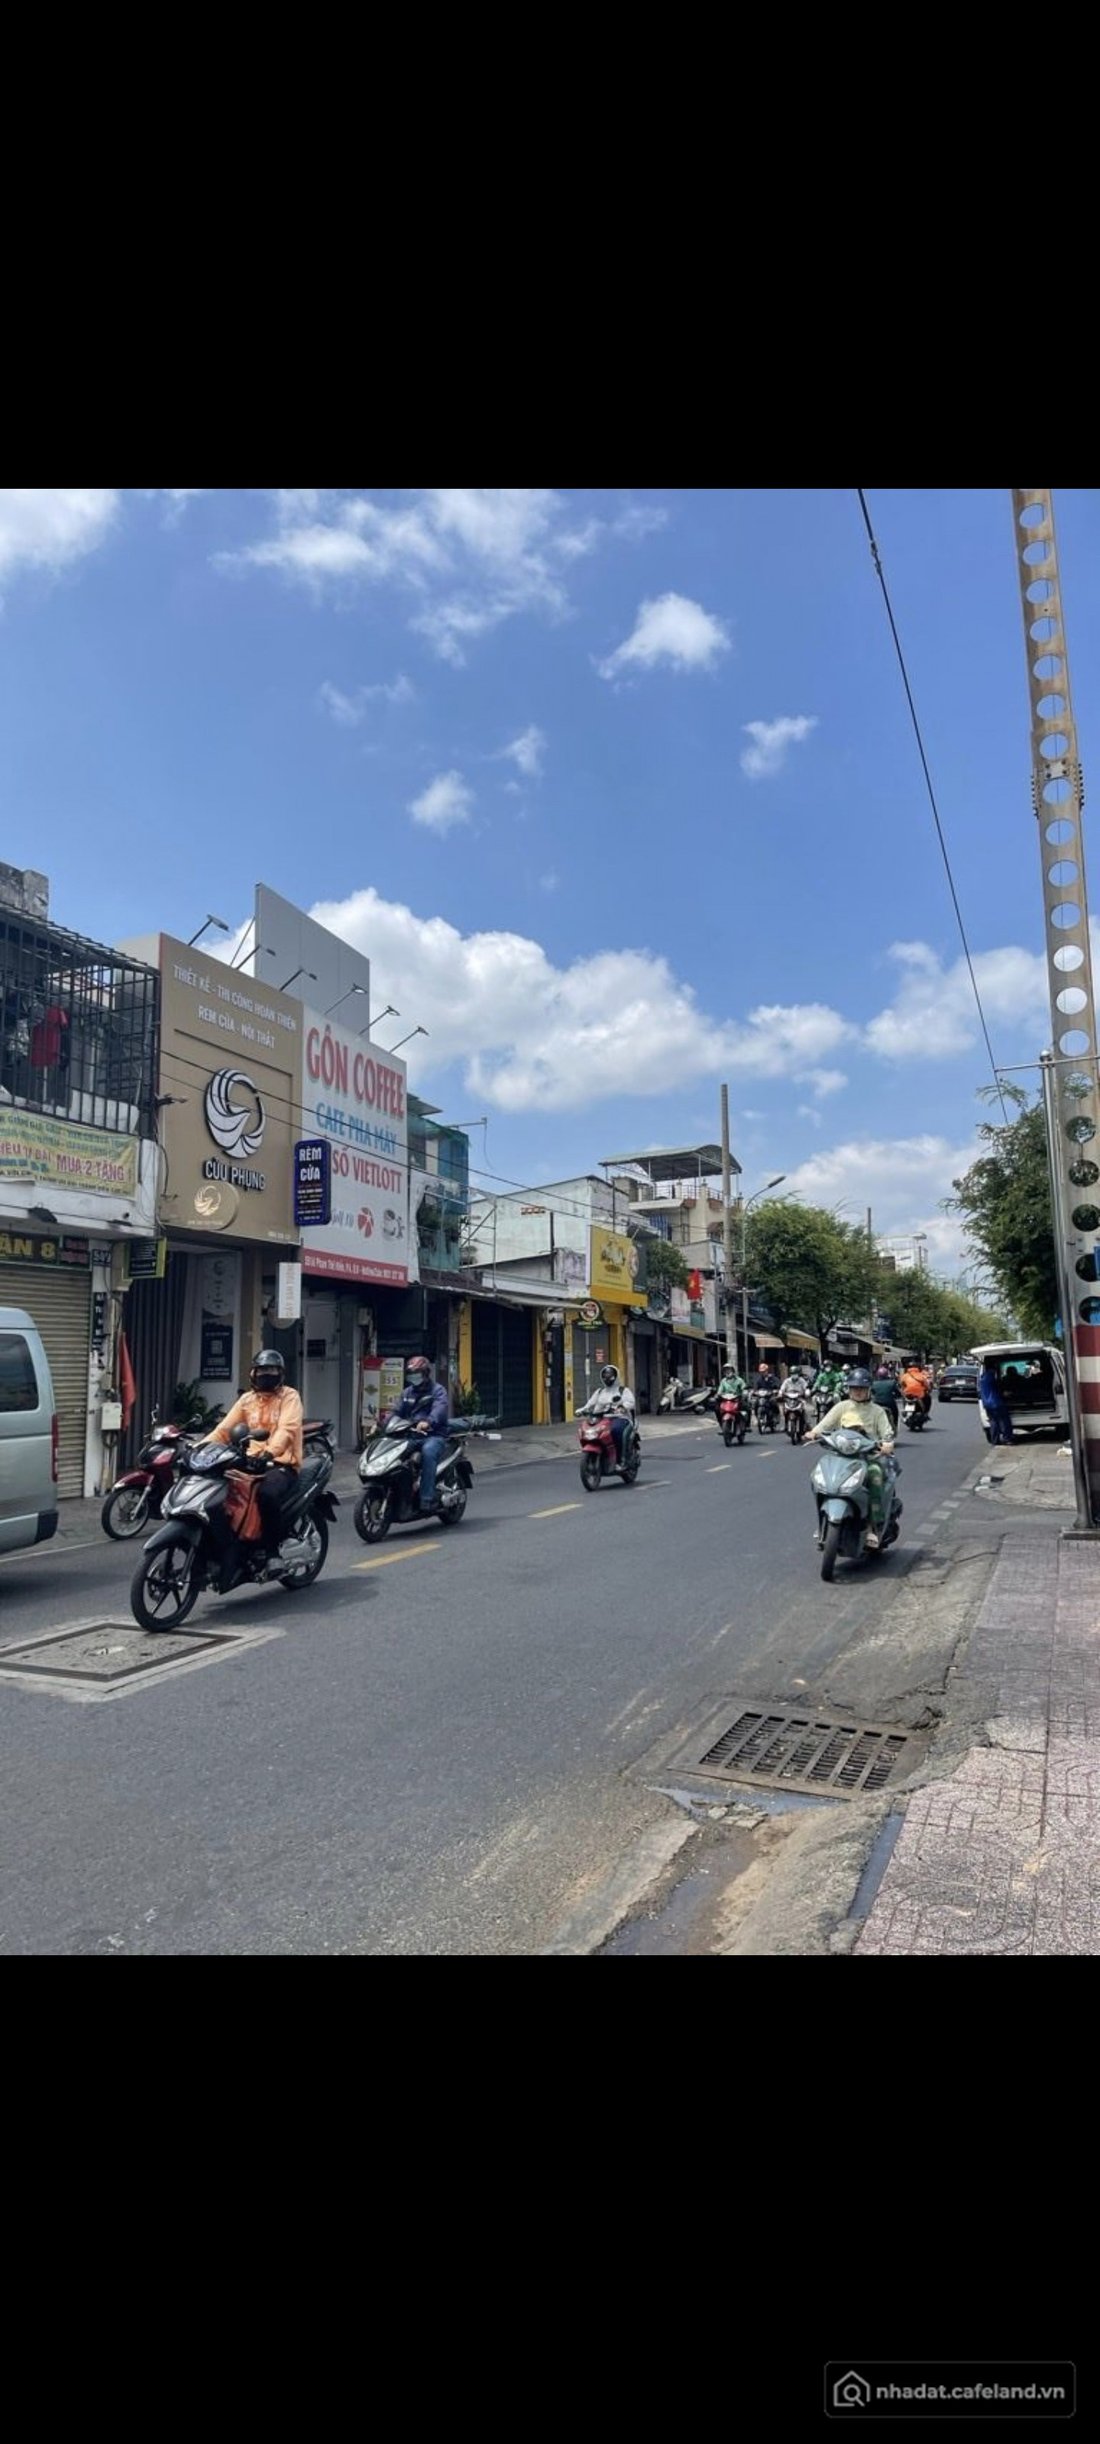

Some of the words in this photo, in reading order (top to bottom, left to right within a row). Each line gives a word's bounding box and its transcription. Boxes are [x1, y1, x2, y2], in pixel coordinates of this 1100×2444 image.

[353, 1051, 404, 1120] COFFEE
[348, 1113, 372, 1147] PHA
[56, 1153, 82, 1174] MUA
[85, 1160, 92, 1176] 2
[352, 1155, 402, 1194] VIETLOTT
[41, 1242, 56, 1258] 8
